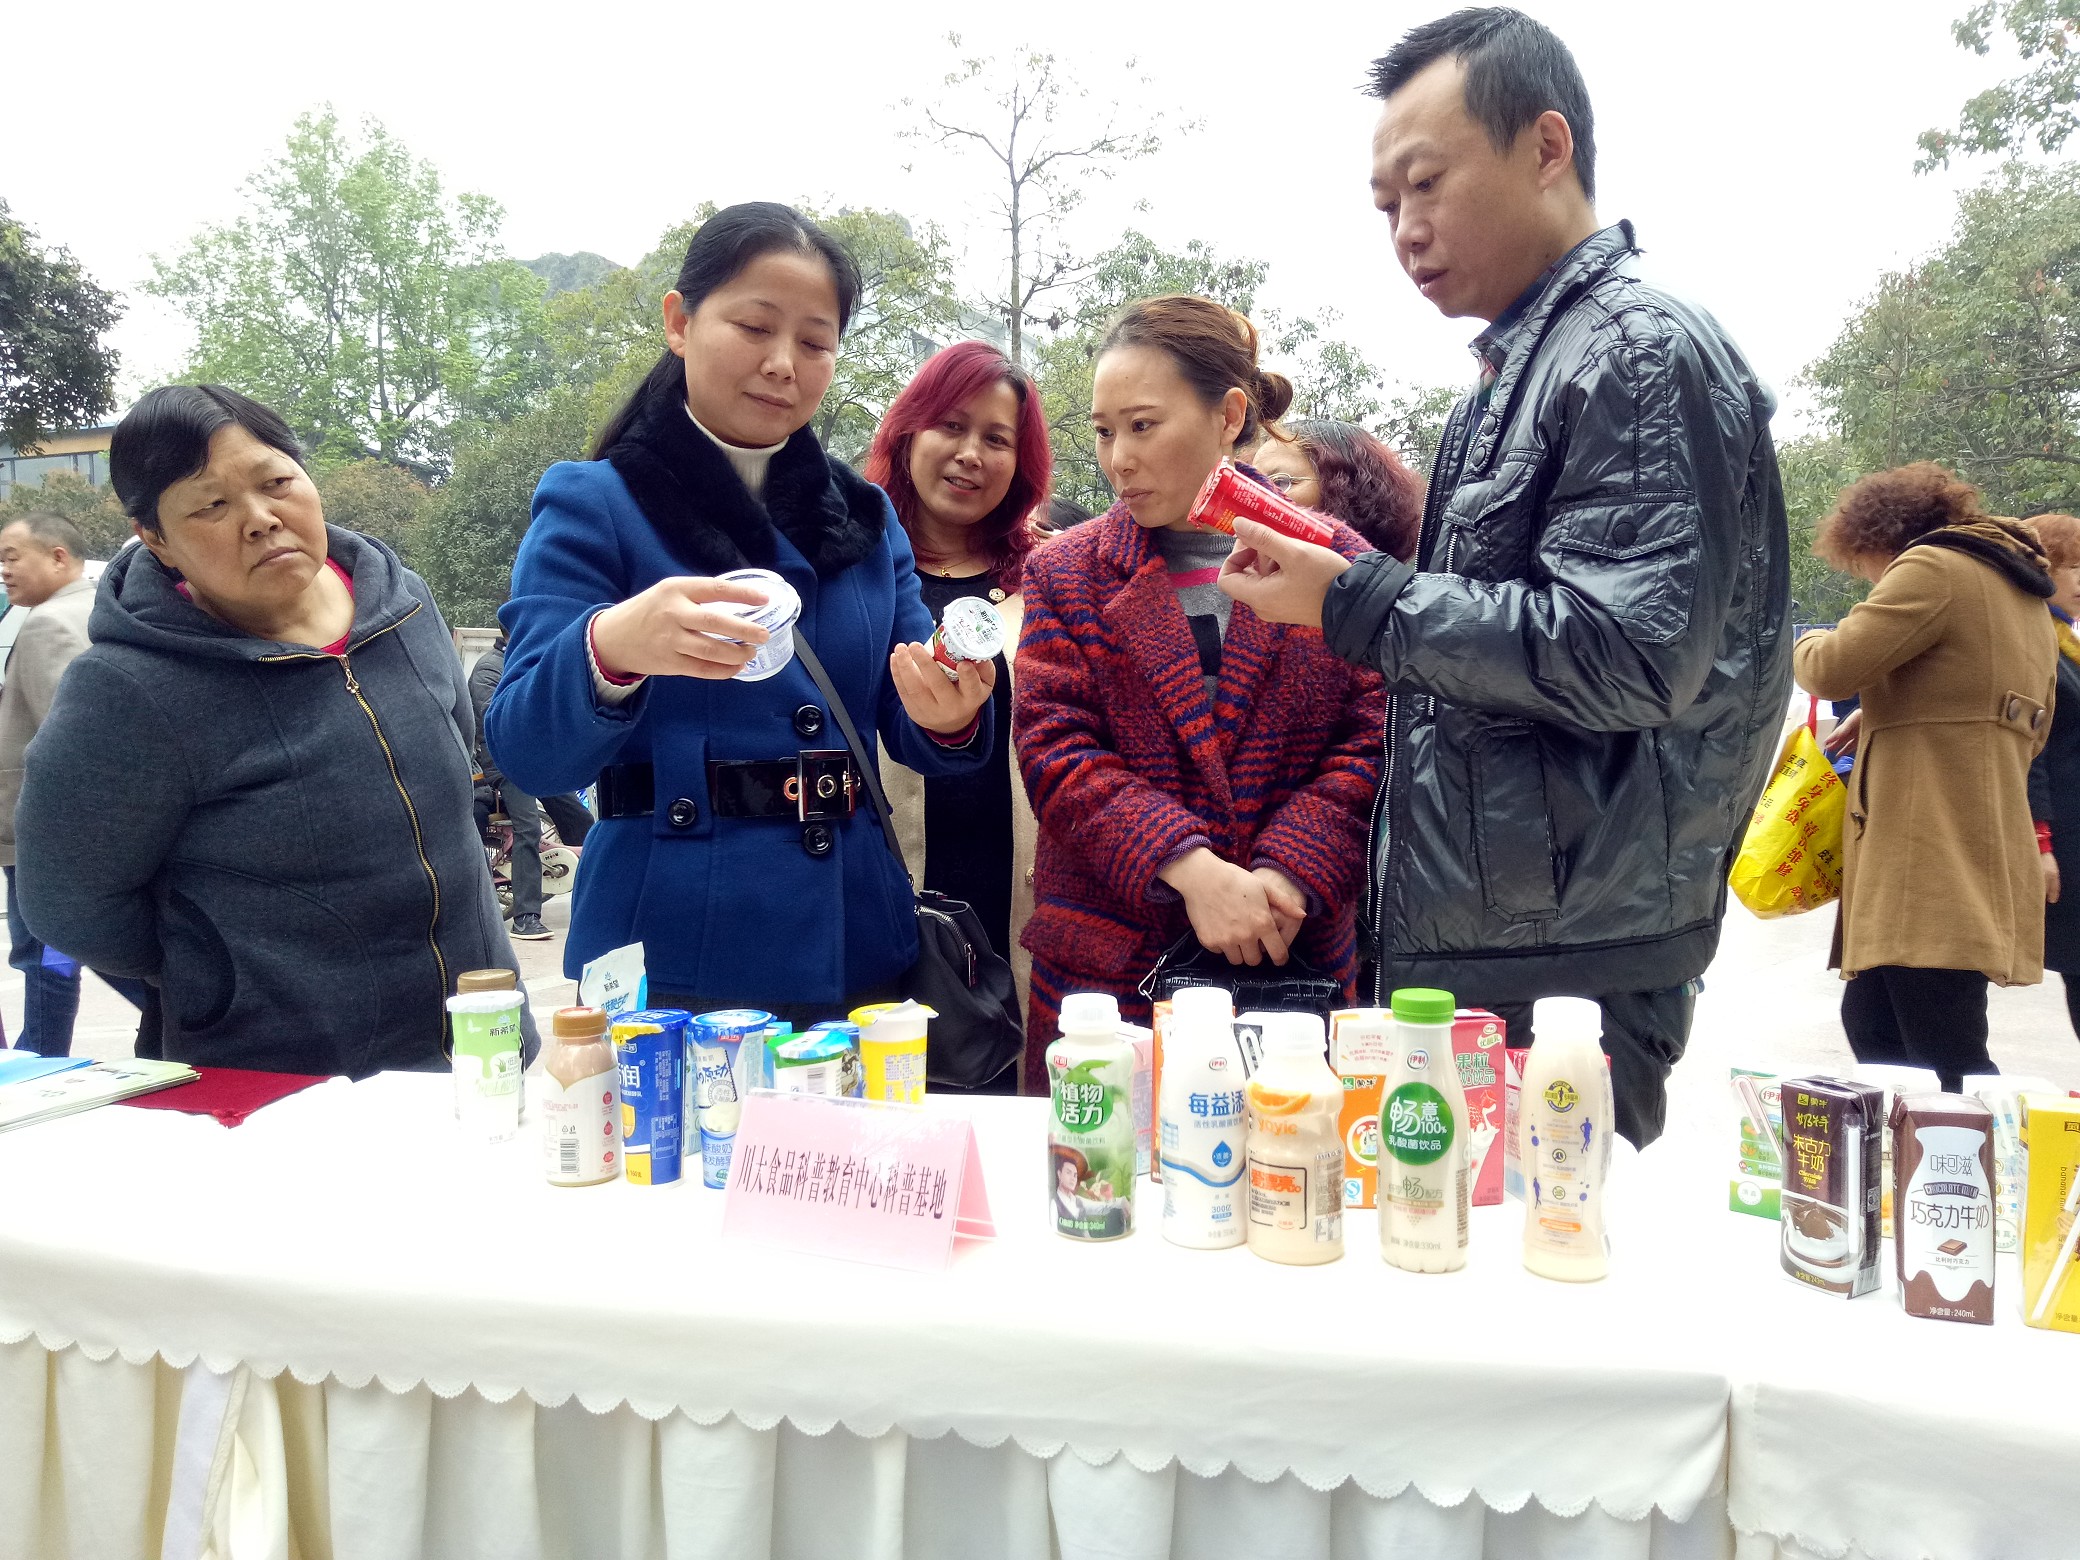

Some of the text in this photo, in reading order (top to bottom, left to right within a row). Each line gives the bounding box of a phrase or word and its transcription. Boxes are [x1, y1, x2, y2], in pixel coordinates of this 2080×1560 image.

[489, 1024, 516, 1037] 新希望
[1410, 1054, 1426, 1065] 伊利
[1456, 1052, 1489, 1070] 果粒
[618, 1063, 640, 1089] 润
[1461, 1068, 1496, 1085] 奶饮品
[1060, 1081, 1104, 1104] 植物
[1189, 1090, 1245, 1117] 每益添
[1060, 1101, 1104, 1125] 活力
[1421, 1121, 1447, 1134] 100%
[1388, 1134, 1442, 1151] 乳酸菌饮品
[1793, 1134, 1831, 1157] 朱古力
[1797, 1151, 1825, 1172] 牛奶
[1930, 1154, 1973, 1177] 味可滋
[736, 1144, 947, 1220] 川大食品科普教育中心科普基地
[1925, 1183, 1960, 1195] CHOCOLATE
[1911, 1200, 1990, 1229] 巧克力牛奶
